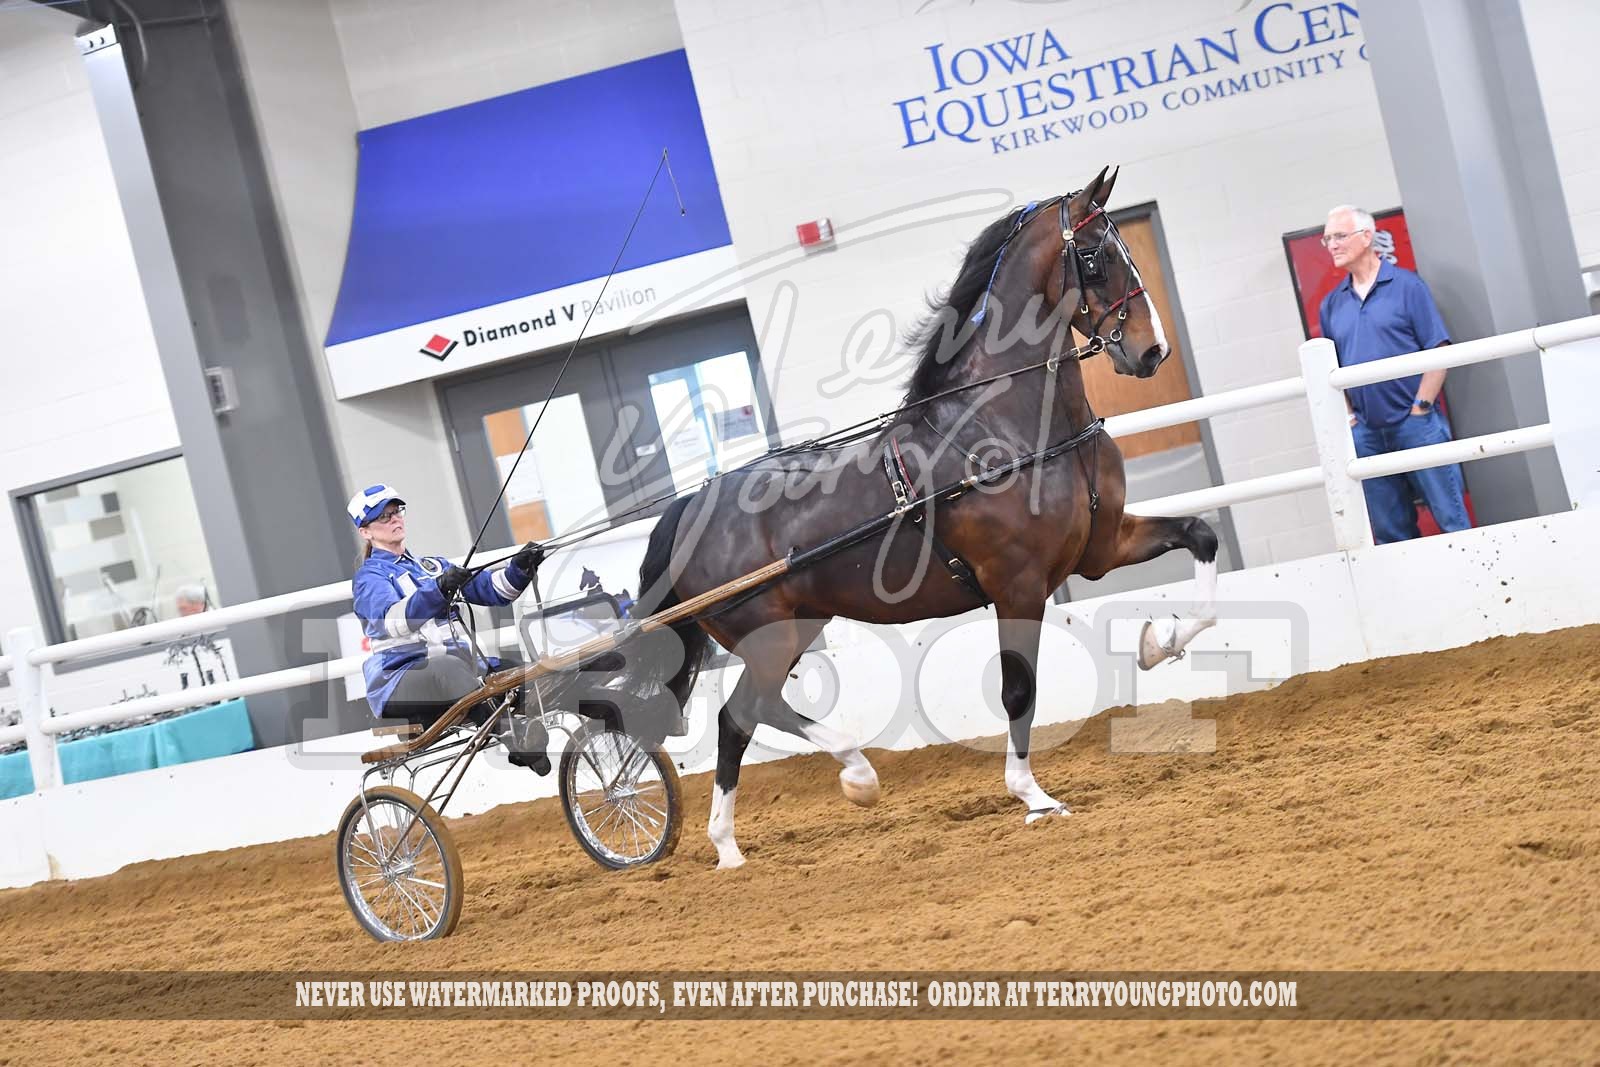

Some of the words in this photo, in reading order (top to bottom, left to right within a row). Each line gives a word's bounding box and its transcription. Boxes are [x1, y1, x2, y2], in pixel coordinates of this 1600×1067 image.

[892, 28, 1240, 149] EQUESTRIAN
[924, 28, 1073, 93] IOWA
[990, 100, 1149, 154] KIRKWOOD
[1161, 49, 1345, 111] COMMUNITY
[463, 309, 557, 348] Diamond
[561, 304, 576, 322] V
[581, 284, 657, 320] Pavilion
